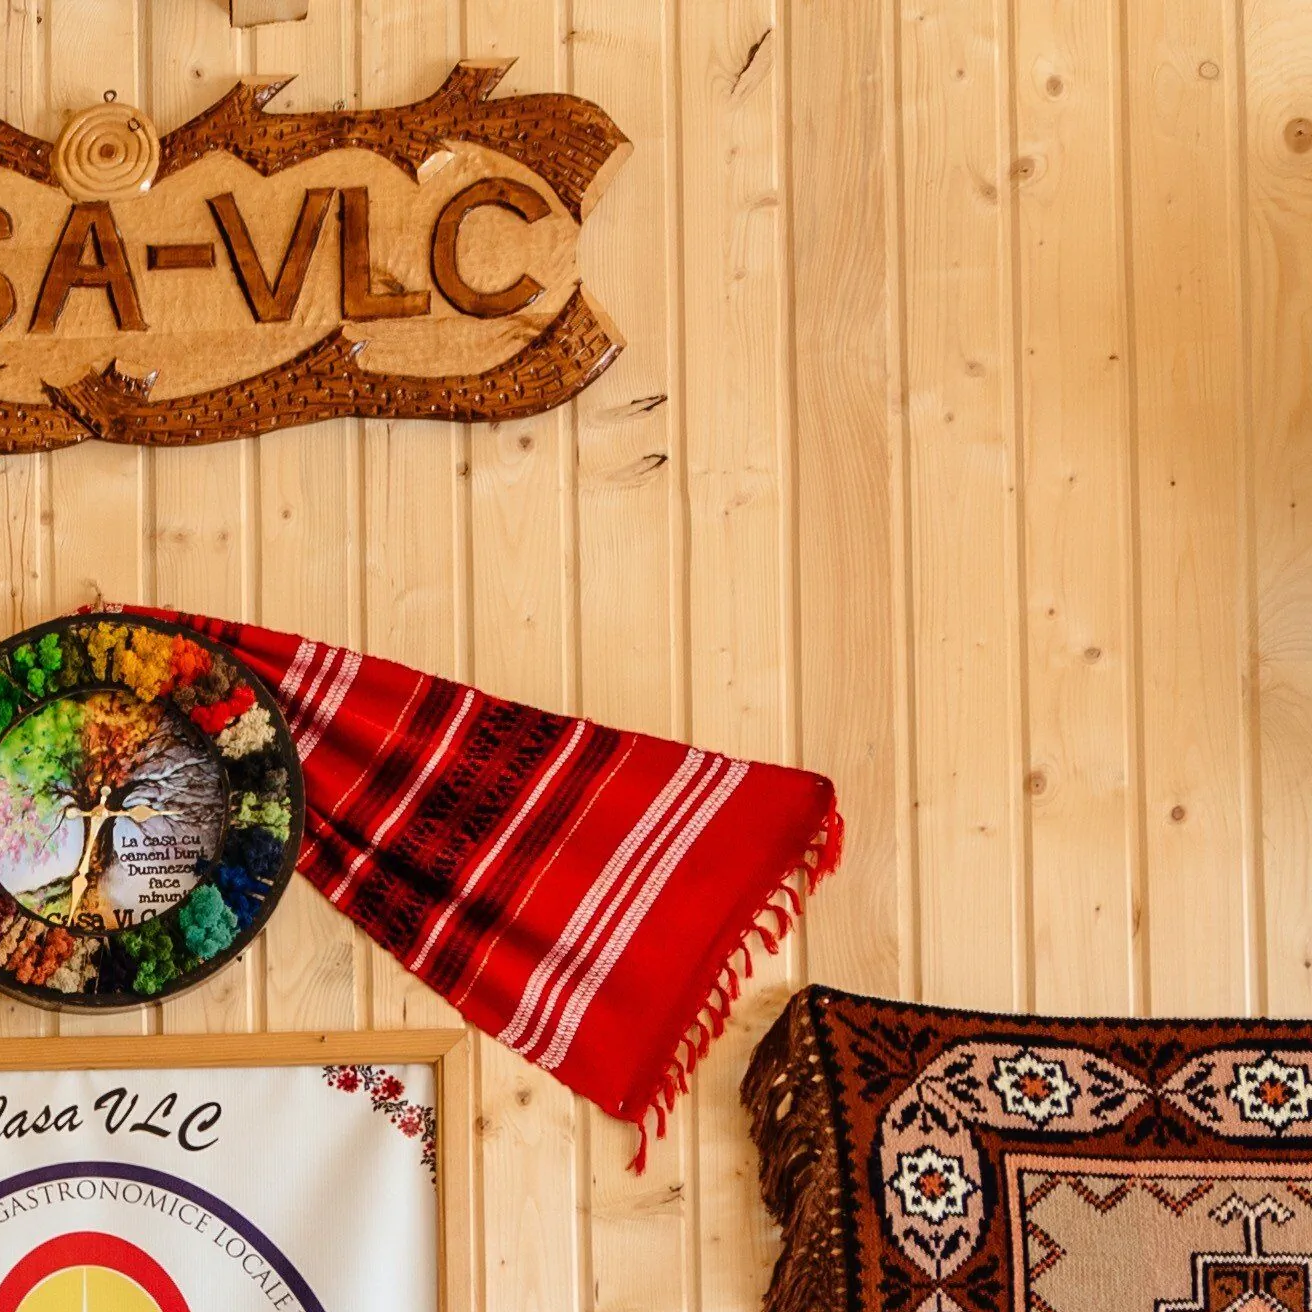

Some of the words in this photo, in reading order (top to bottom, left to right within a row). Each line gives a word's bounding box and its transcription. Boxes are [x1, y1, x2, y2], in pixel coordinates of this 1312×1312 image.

[121, 836, 138, 848] La
[142, 835, 177, 847] casa
[181, 834, 202, 846] cu
[148, 877, 181, 890] face
[94, 1086, 222, 1152] VLC
[212, 1226, 294, 1311] LOCALE
